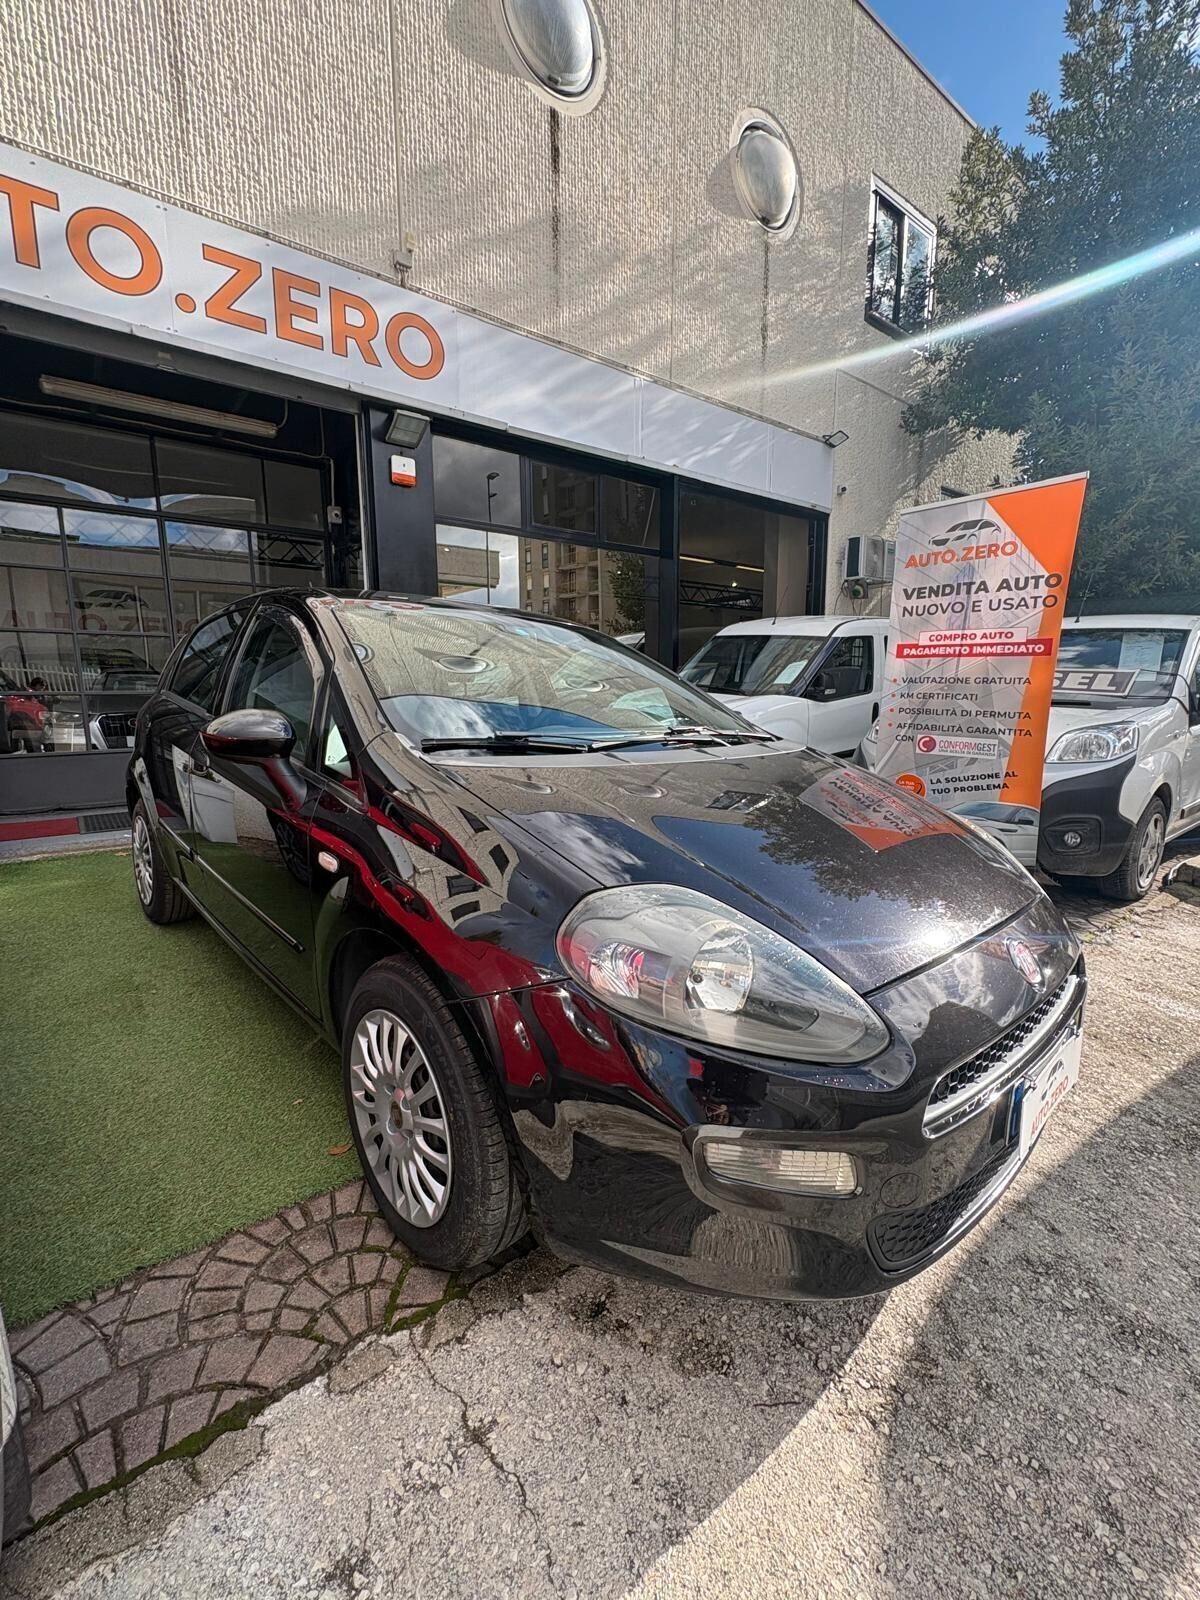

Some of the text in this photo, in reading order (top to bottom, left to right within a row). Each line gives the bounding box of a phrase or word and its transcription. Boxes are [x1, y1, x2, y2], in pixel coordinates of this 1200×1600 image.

[905, 540, 1019, 569] AUTO.ZERO
[903, 573, 1063, 600] VENDITA AUTO
[902, 595, 1058, 617] NUOVO E USATO
[929, 631, 1014, 642] COMPRO AUTO
[903, 644, 1045, 655] PAGAMENTO IMMEDIATO
[901, 676, 1032, 685] VALUTAZIONE GRATUITA
[900, 692, 978, 701] KM CERTIFICATI
[898, 707, 1032, 720] POSSIBILITÀ DI PERMUTA
[896, 722, 1032, 737] AFFIDABILITÀ GARANTITA
[895, 735, 914, 743] CON
[938, 739, 997, 753] CONFORMGEST
[930, 771, 1018, 785] LA SOLUZIONE AL
[931, 782, 1009, 795] TUO PROBLEMA
